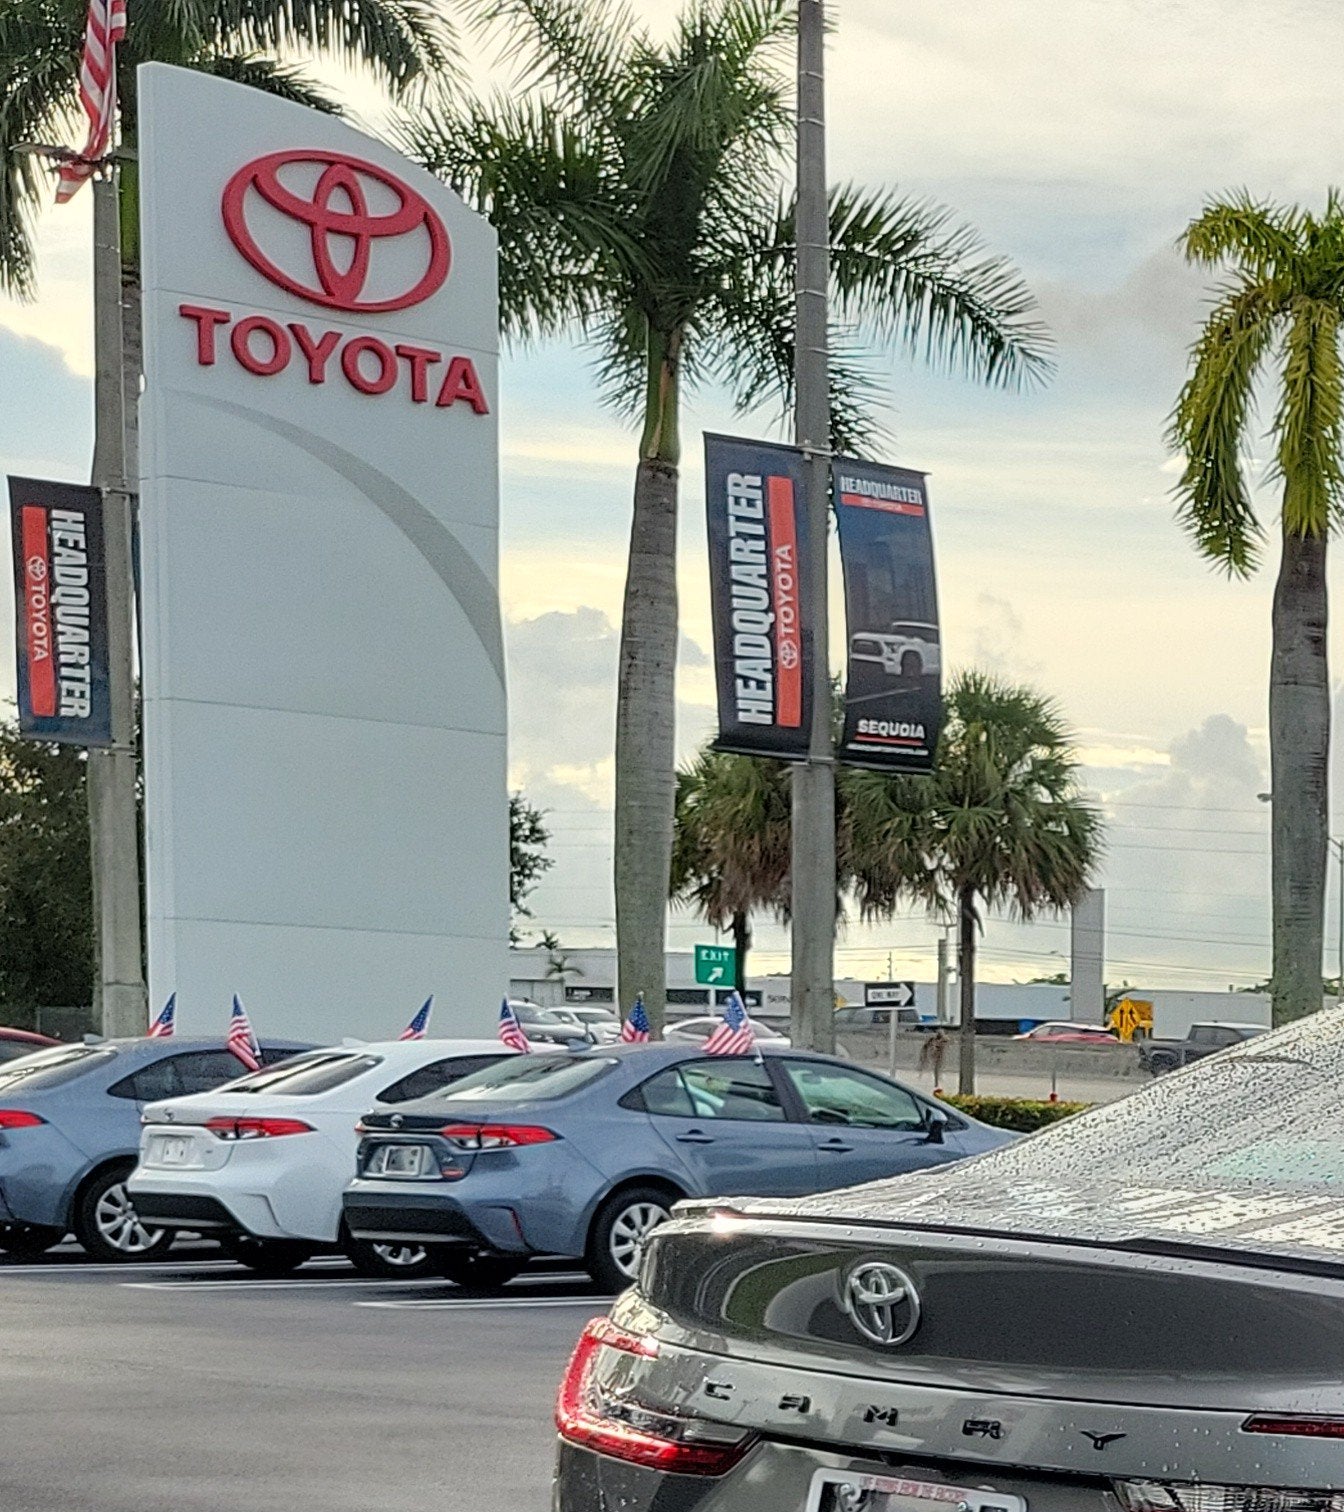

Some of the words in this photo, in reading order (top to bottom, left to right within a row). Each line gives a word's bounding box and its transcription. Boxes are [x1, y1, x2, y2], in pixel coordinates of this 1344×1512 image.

[179, 304, 490, 416] TOYOTA
[841, 476, 923, 505] HEADQUARTER
[30, 585, 50, 662] TOYOTA
[51, 509, 92, 719] HEADQUARTER
[727, 472, 775, 725] HEADQUARTER
[773, 544, 797, 636] TOYOTA
[857, 719, 925, 739] SEQUOIA
[701, 949, 730, 961] EXIT
[705, 1381, 1128, 1450] CAMRY
